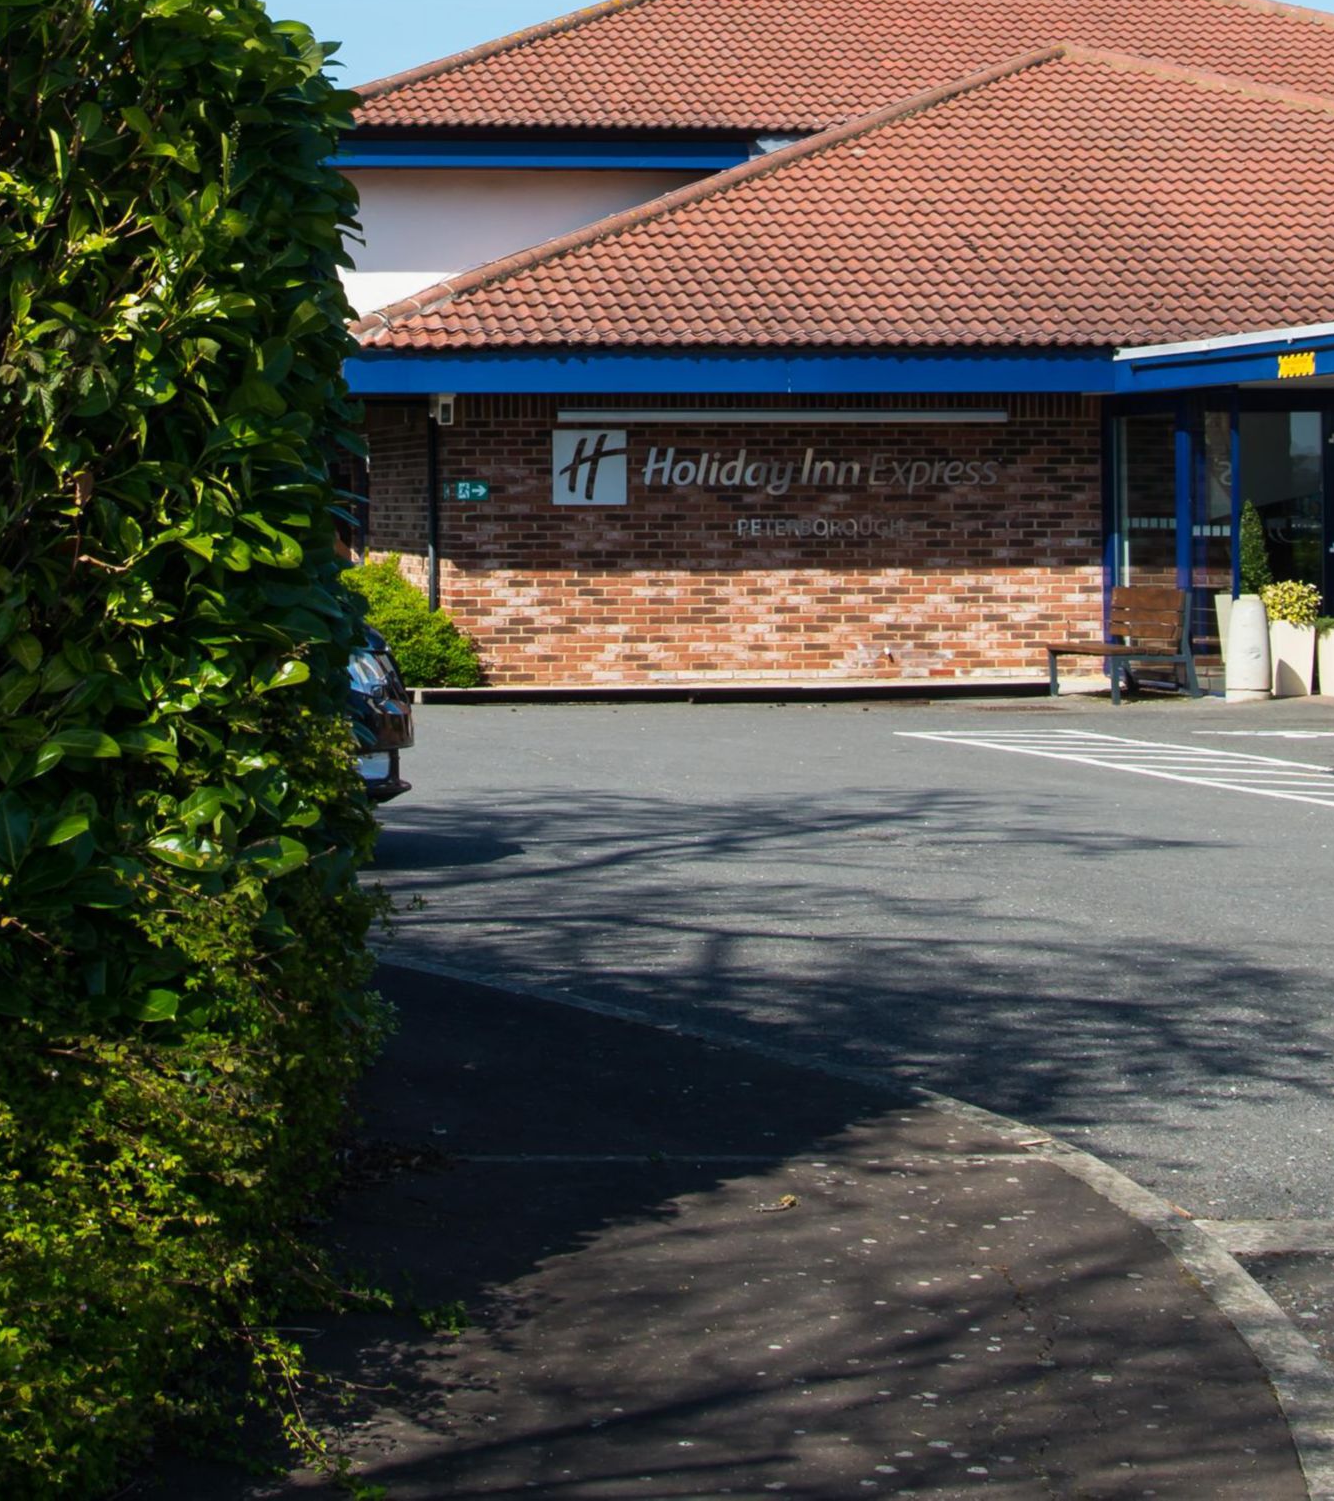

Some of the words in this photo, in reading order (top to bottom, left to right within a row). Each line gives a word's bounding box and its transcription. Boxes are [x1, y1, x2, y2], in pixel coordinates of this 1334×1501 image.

[641, 446, 798, 497] Holiday
[801, 448, 861, 485] Inn
[869, 453, 999, 493] Express
[736, 518, 905, 537] PETERBOROUGH
